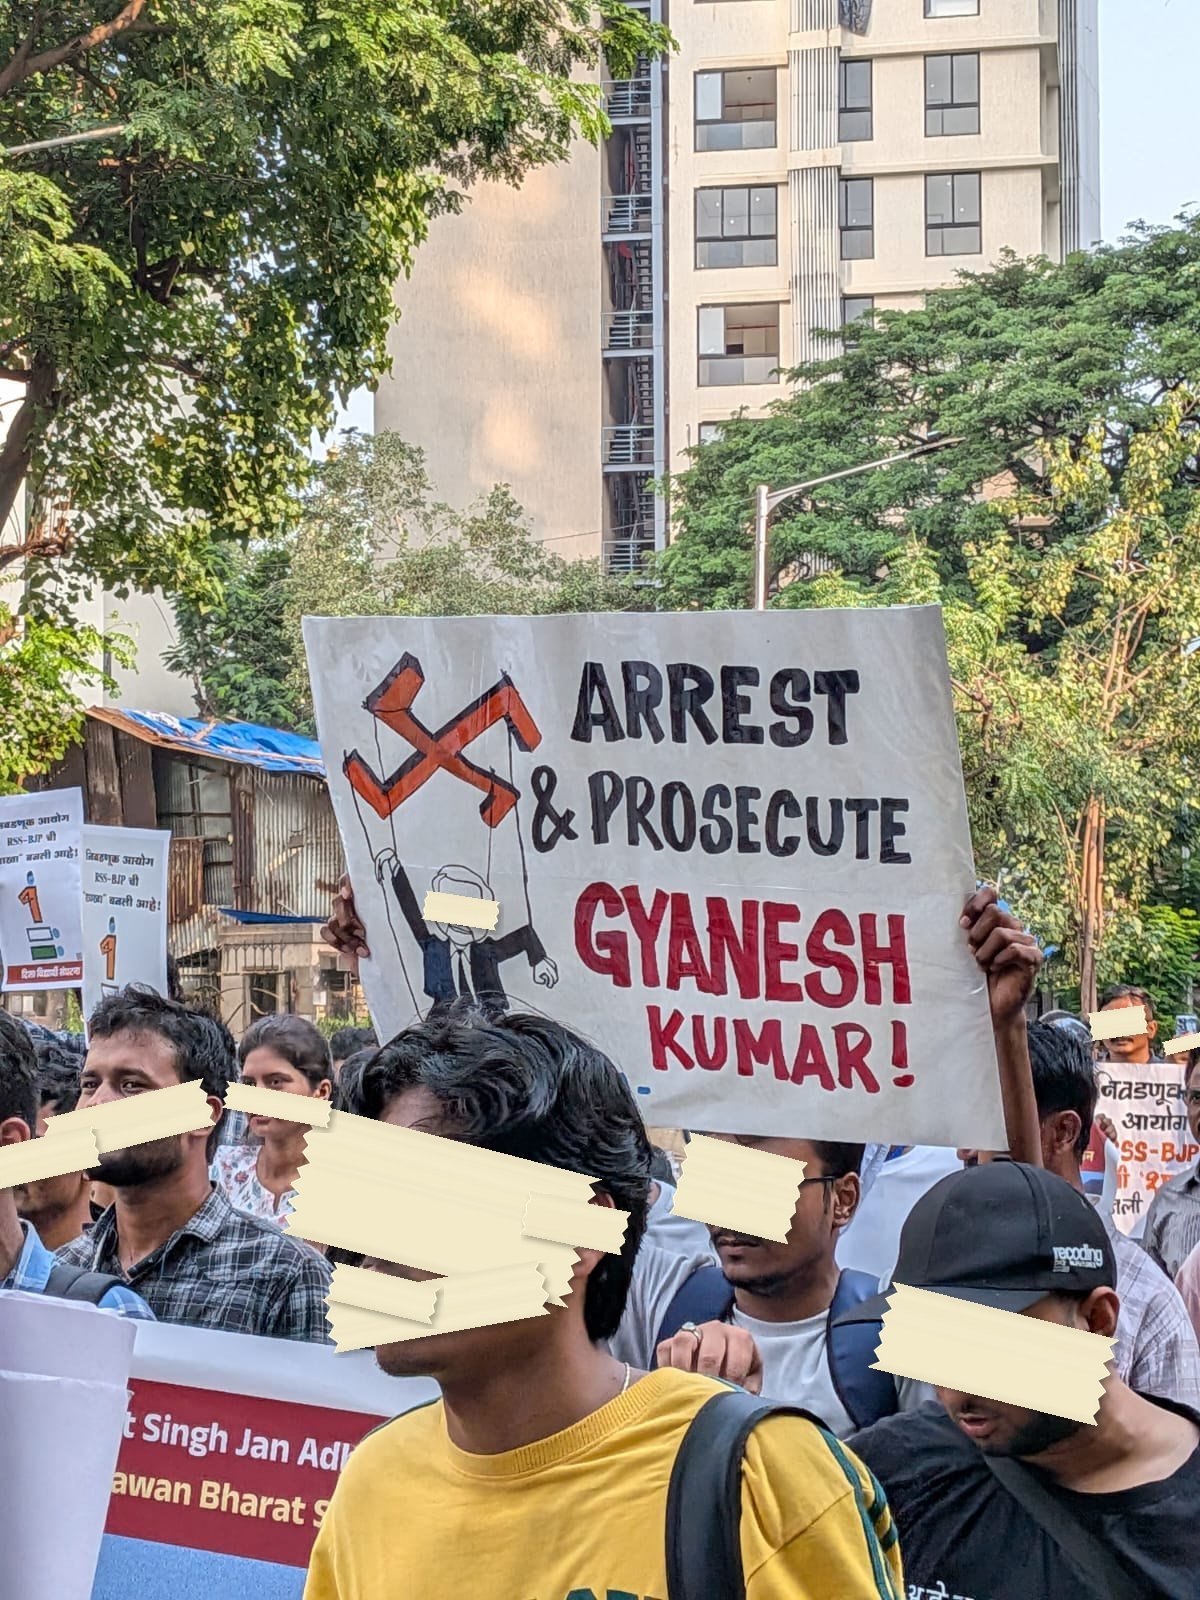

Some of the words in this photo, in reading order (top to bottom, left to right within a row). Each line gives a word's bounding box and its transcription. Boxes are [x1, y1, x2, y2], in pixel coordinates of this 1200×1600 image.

[570, 660, 860, 748] ARREST
[7, 833, 43, 846] RSS-BJP
[532, 765, 578, 853] &
[589, 770, 911, 864] PROSECUTE
[94, 871, 126, 885] RSS-BJP
[122, 852, 154, 867] आयोग
[574, 881, 911, 1009] GYANESH
[646, 1005, 915, 1094] KUMAR!
[1122, 1105, 1187, 1131] आयोग
[1118, 1139, 1200, 1163] SS-BJP
[142, 1413, 228, 1457] Singh
[235, 1428, 290, 1463] Jan
[111, 1471, 191, 1506] awan
[199, 1480, 307, 1526] Bharat
